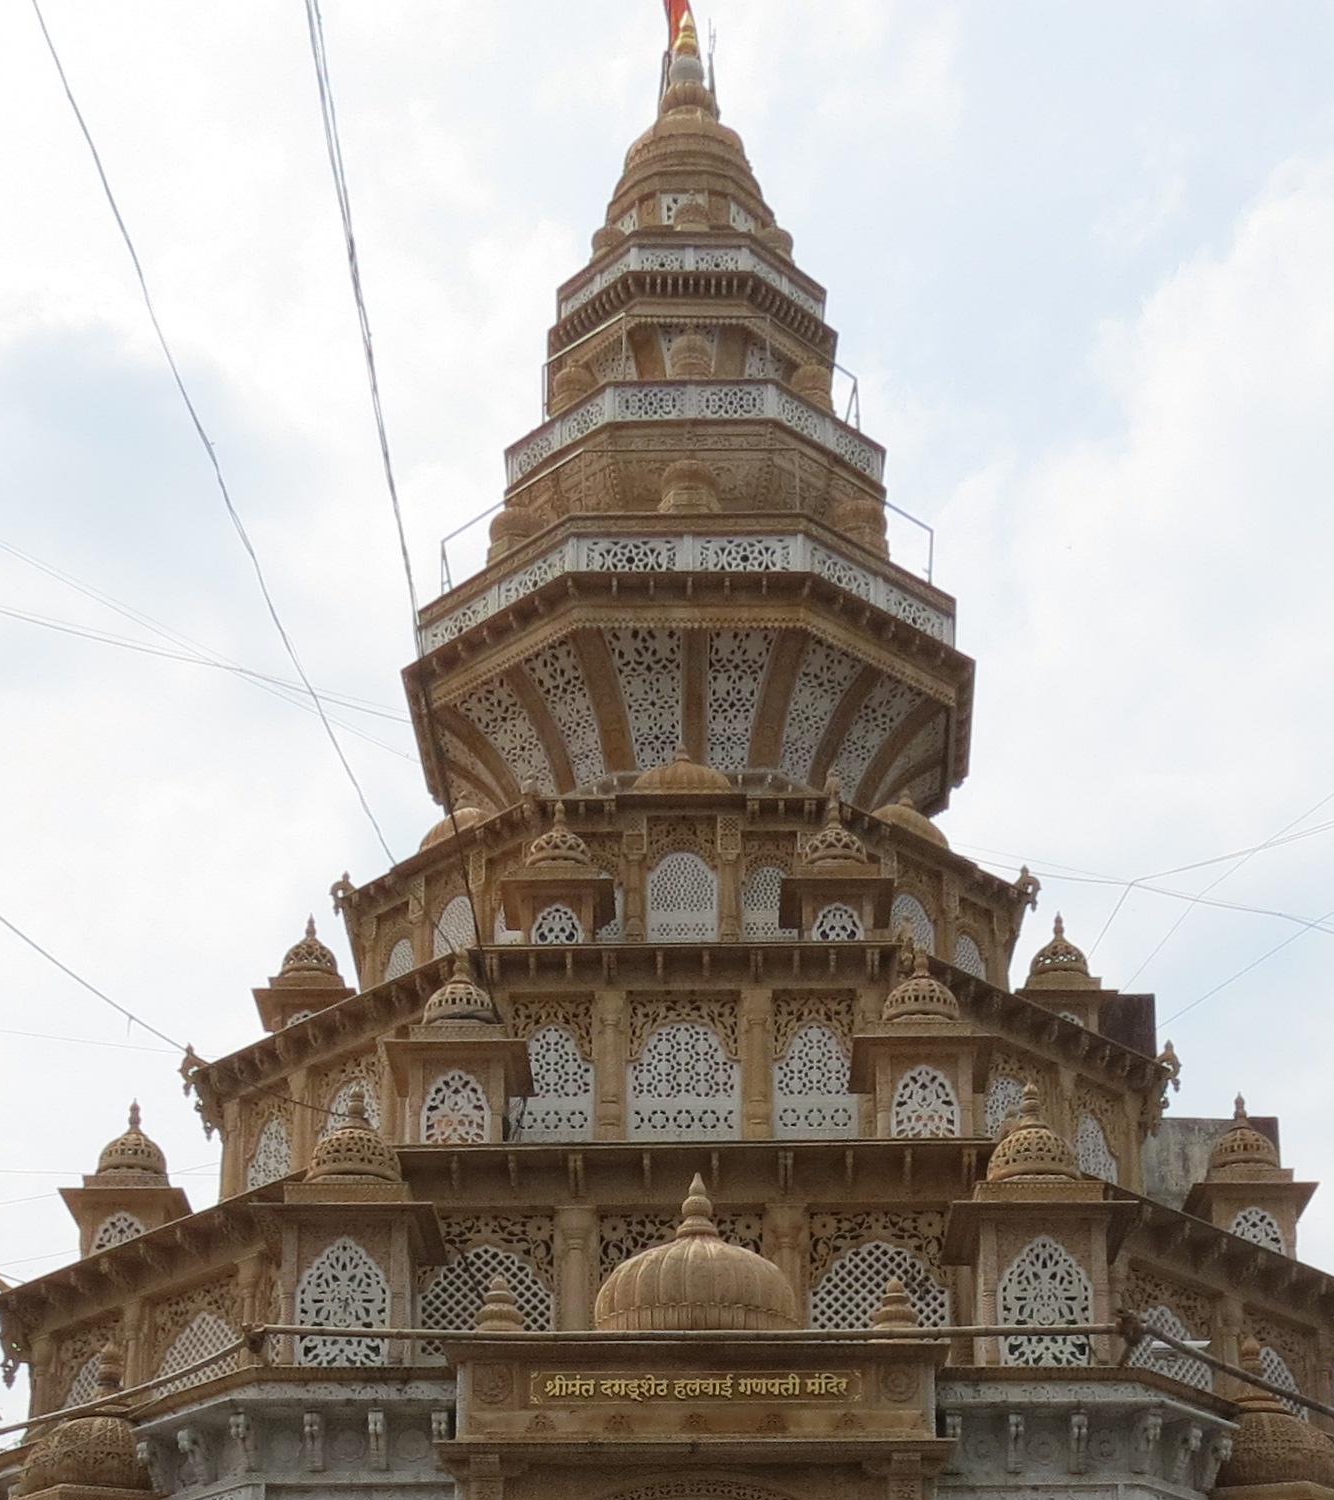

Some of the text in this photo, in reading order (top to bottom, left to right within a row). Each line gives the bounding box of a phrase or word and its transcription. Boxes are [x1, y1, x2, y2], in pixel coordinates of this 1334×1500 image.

[544, 1374, 595, 1398] श्रीमंत
[674, 1373, 734, 1401] हलवाई
[738, 1374, 800, 1397] गणपती
[805, 1373, 848, 1396] मंदिर
